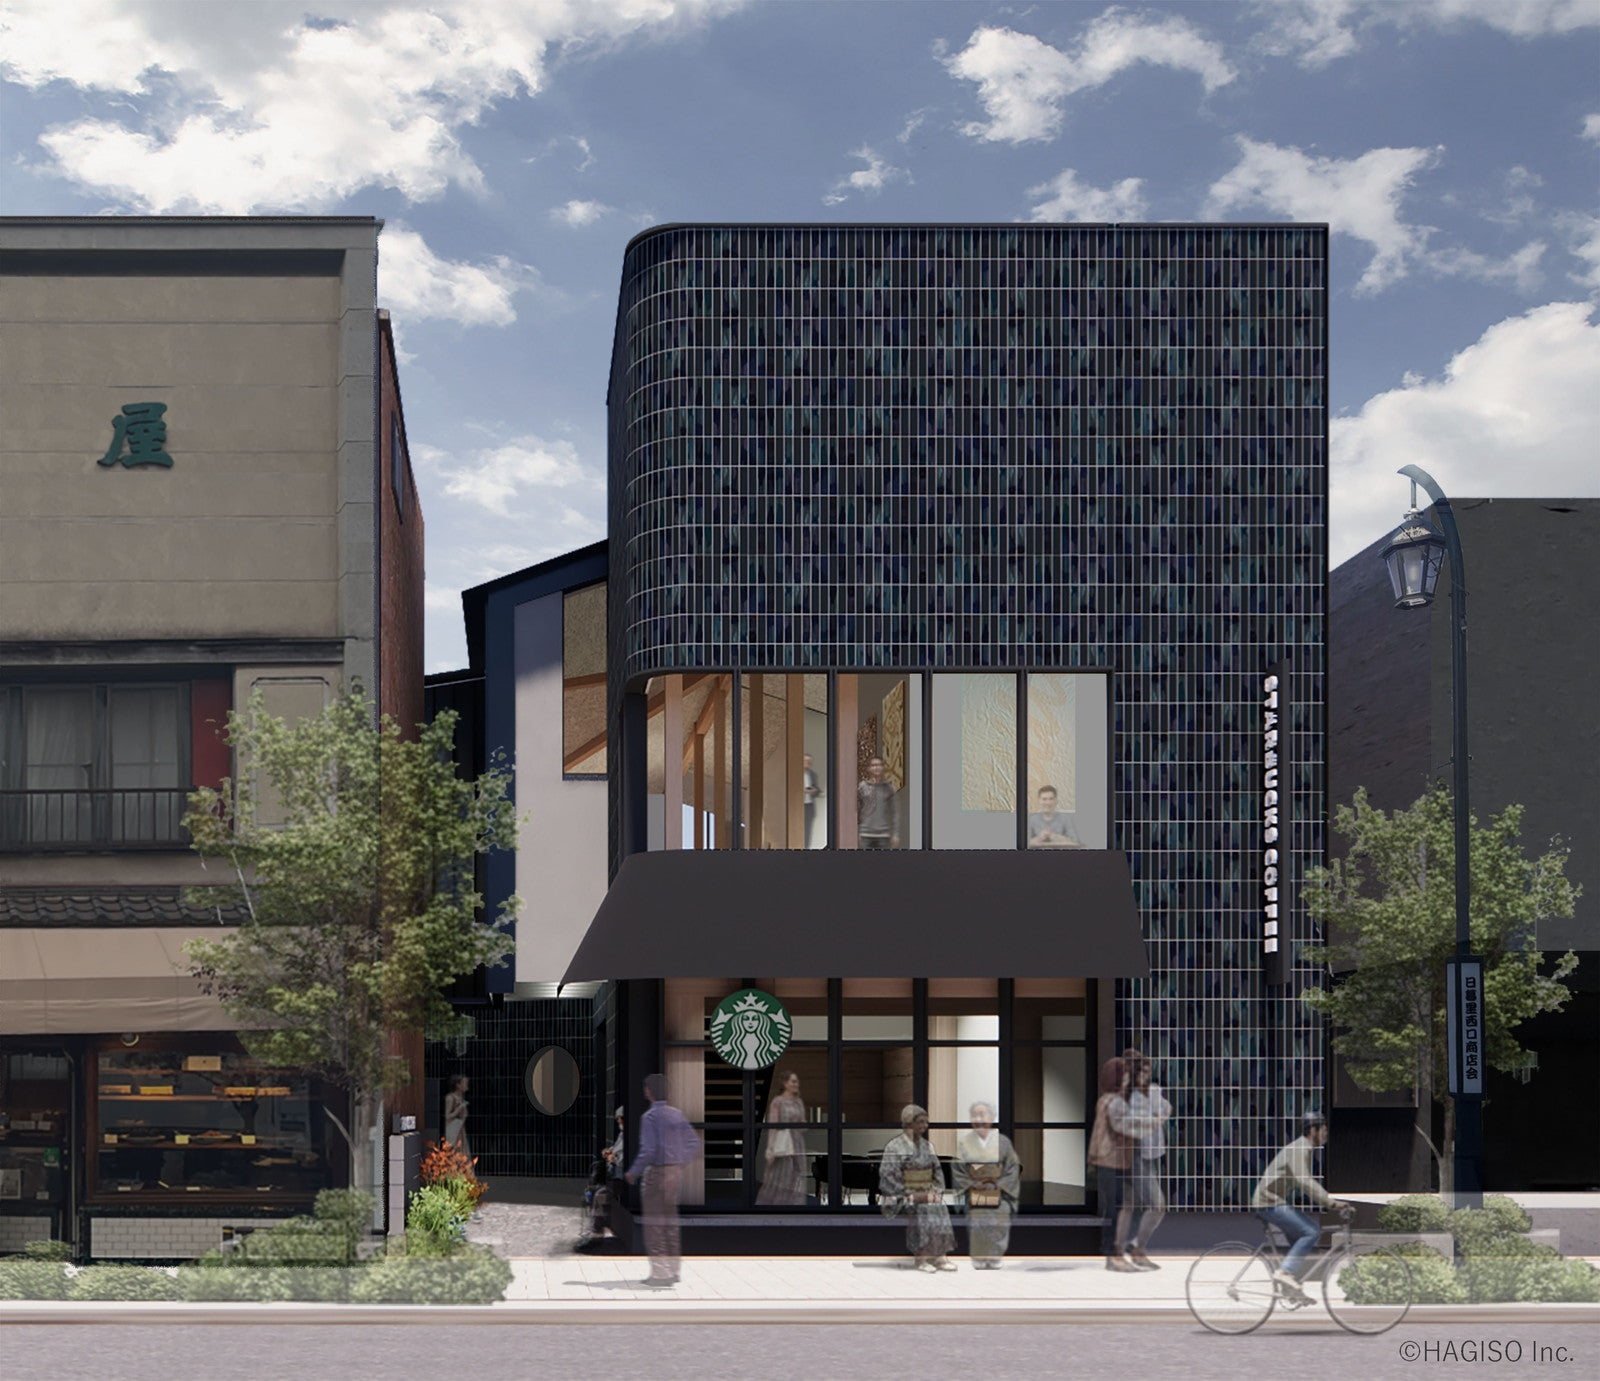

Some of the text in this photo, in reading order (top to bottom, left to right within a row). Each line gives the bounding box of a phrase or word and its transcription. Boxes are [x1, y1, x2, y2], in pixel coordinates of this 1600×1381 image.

[97, 402, 174, 469] 屋
[1264, 675, 1278, 843] STARBUCKS
[1465, 976, 1478, 1080] 日暮里西口商店会
